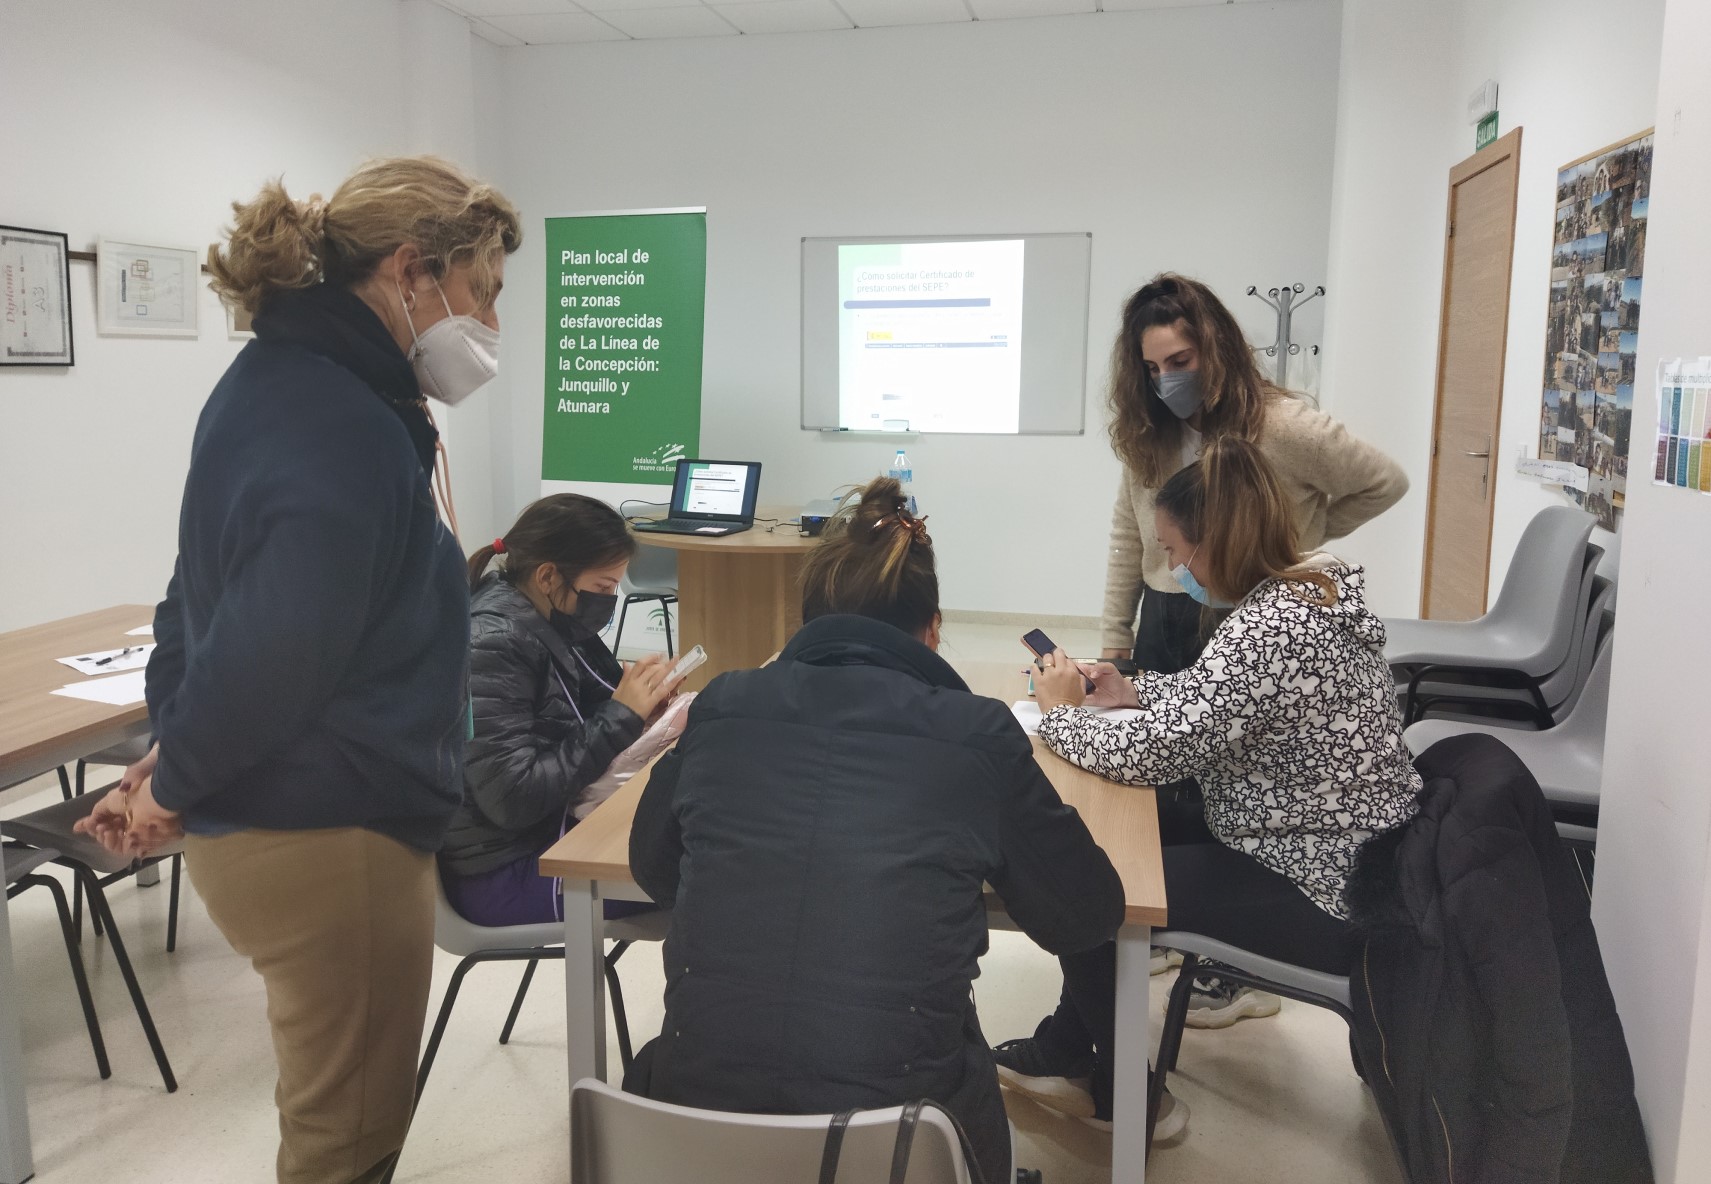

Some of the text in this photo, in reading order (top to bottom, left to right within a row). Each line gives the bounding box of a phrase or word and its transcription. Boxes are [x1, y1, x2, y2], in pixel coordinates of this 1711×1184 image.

[1477, 120, 1496, 149] SALIDA
[561, 249, 650, 265] Plan local de
[561, 271, 645, 286] intervención
[886, 271, 917, 280] solicitar
[920, 270, 963, 280] Certificado
[965, 270, 975, 279] de
[5, 265, 16, 323] Diploma
[857, 282, 949, 294] prestaciones del SEPE?
[560, 294, 621, 307] en zonas
[560, 314, 663, 329] desfavorecidas
[559, 335, 660, 350] de La Línea de
[559, 356, 660, 374] la Concepción:
[558, 377, 630, 396] Junquillo y
[557, 398, 610, 413] Atunara
